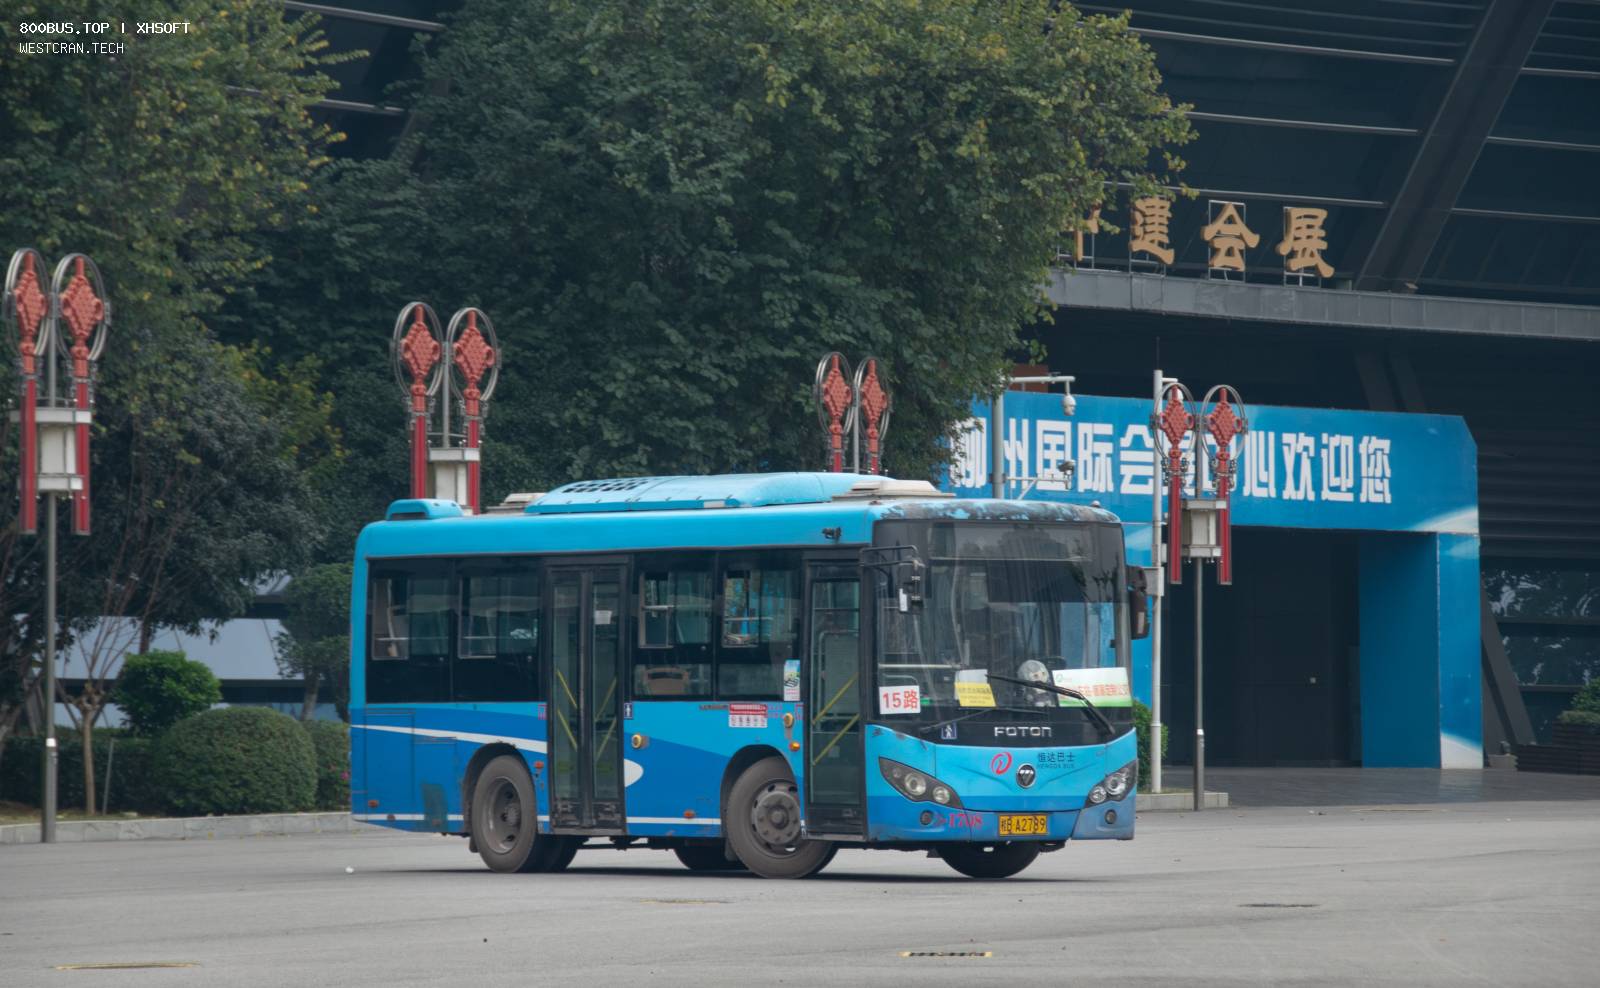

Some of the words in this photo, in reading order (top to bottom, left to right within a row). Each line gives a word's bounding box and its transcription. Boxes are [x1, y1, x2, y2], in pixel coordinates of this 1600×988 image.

[883, 689, 918, 709] 15路
[993, 726, 1053, 738] FOTON
[1038, 751, 1076, 763] 恒达巴士
